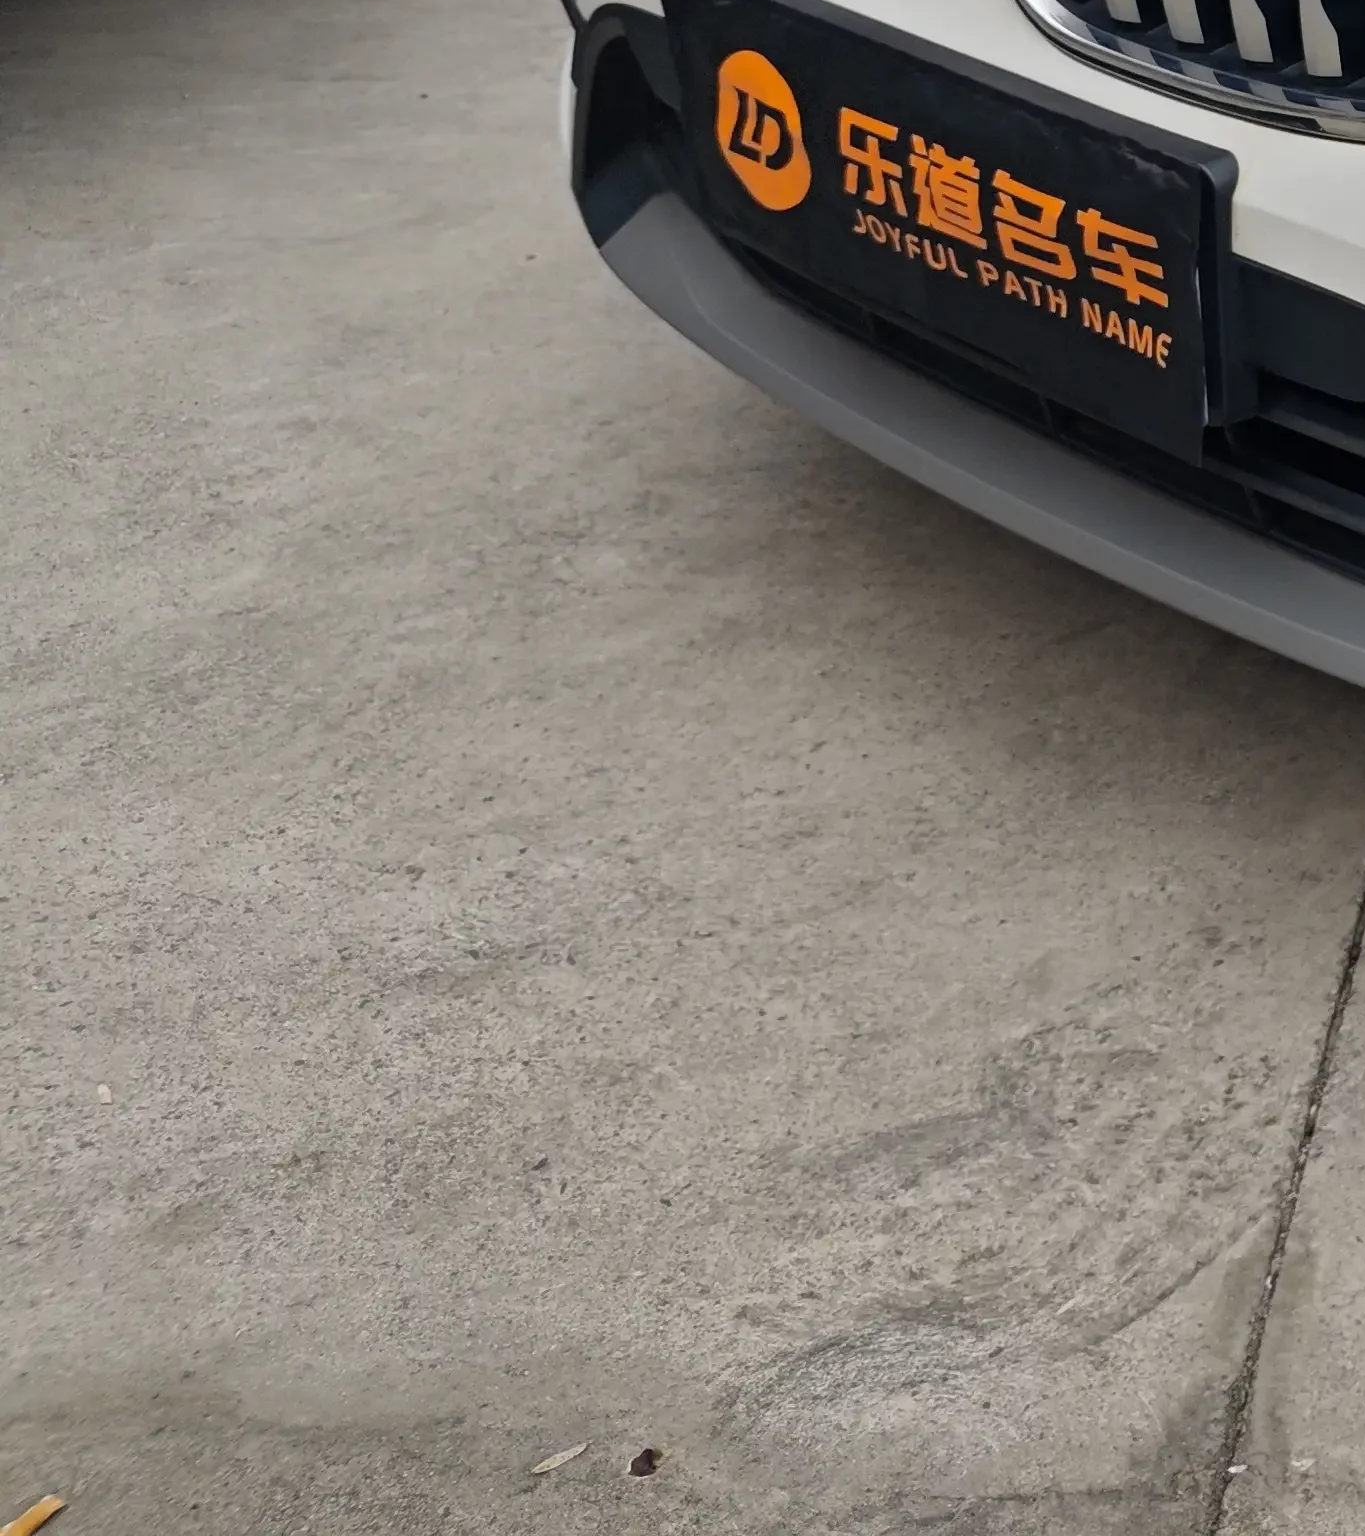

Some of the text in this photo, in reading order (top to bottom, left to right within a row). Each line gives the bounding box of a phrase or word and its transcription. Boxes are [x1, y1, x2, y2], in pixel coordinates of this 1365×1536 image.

[838, 106, 1170, 309] 乐道名车
[851, 208, 1173, 369] JOYFUL PATH NAME
